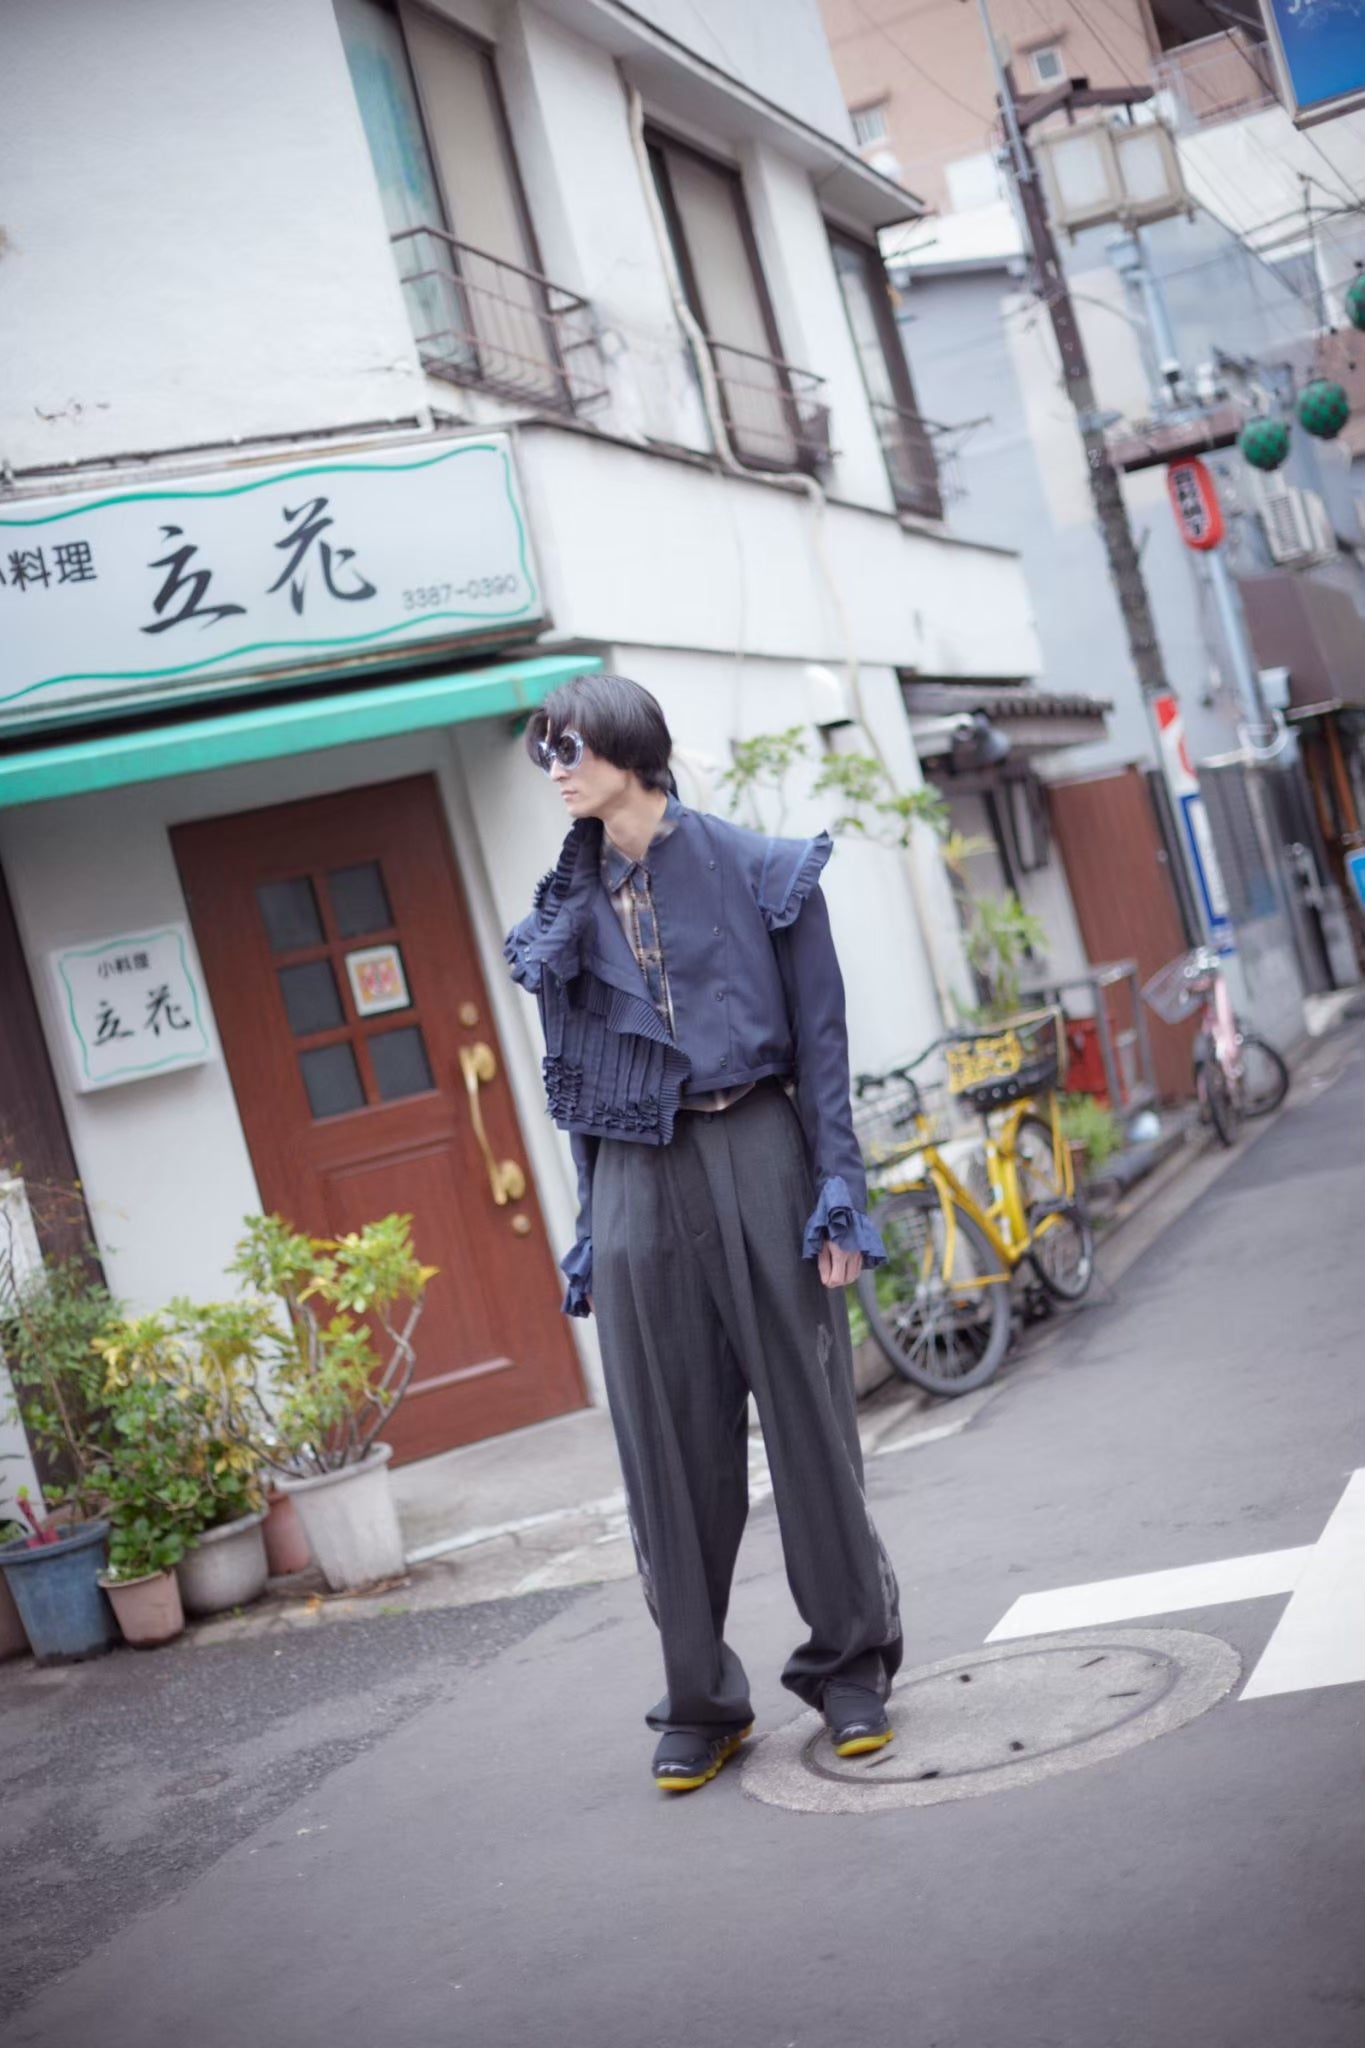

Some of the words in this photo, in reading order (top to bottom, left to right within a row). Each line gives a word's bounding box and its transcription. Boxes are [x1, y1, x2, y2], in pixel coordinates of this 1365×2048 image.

[0, 540, 97, 592] 料理
[140, 497, 376, 634] 立花
[98, 951, 150, 979] 小料理
[94, 983, 190, 1046] 立花
